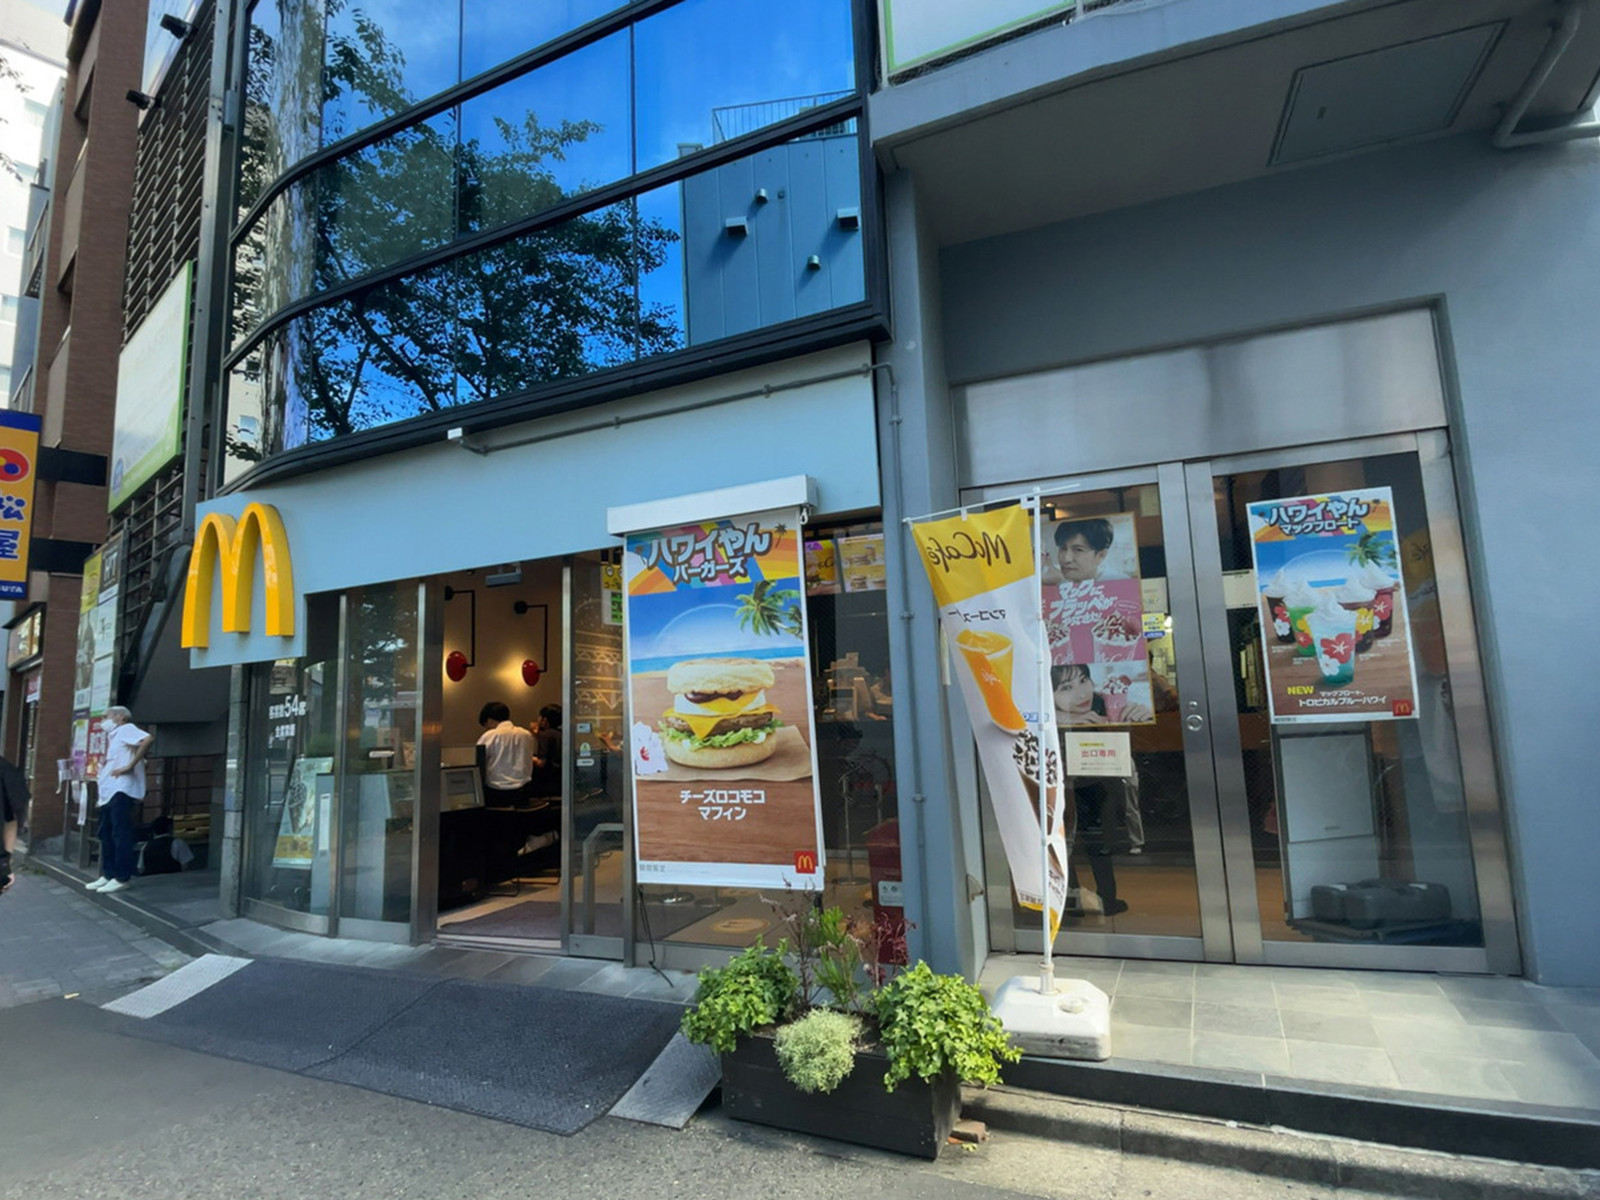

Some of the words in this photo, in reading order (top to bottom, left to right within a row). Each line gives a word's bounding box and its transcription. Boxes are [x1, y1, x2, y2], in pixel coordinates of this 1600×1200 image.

[1269, 498, 1369, 526] ハワイやん
[1280, 517, 1359, 535] マックフロート
[647, 522, 772, 569] ハワイやん
[1287, 686, 1314, 695] NEW
[680, 790, 766, 804] チーズロコモコ
[698, 806, 747, 821] マフィン
